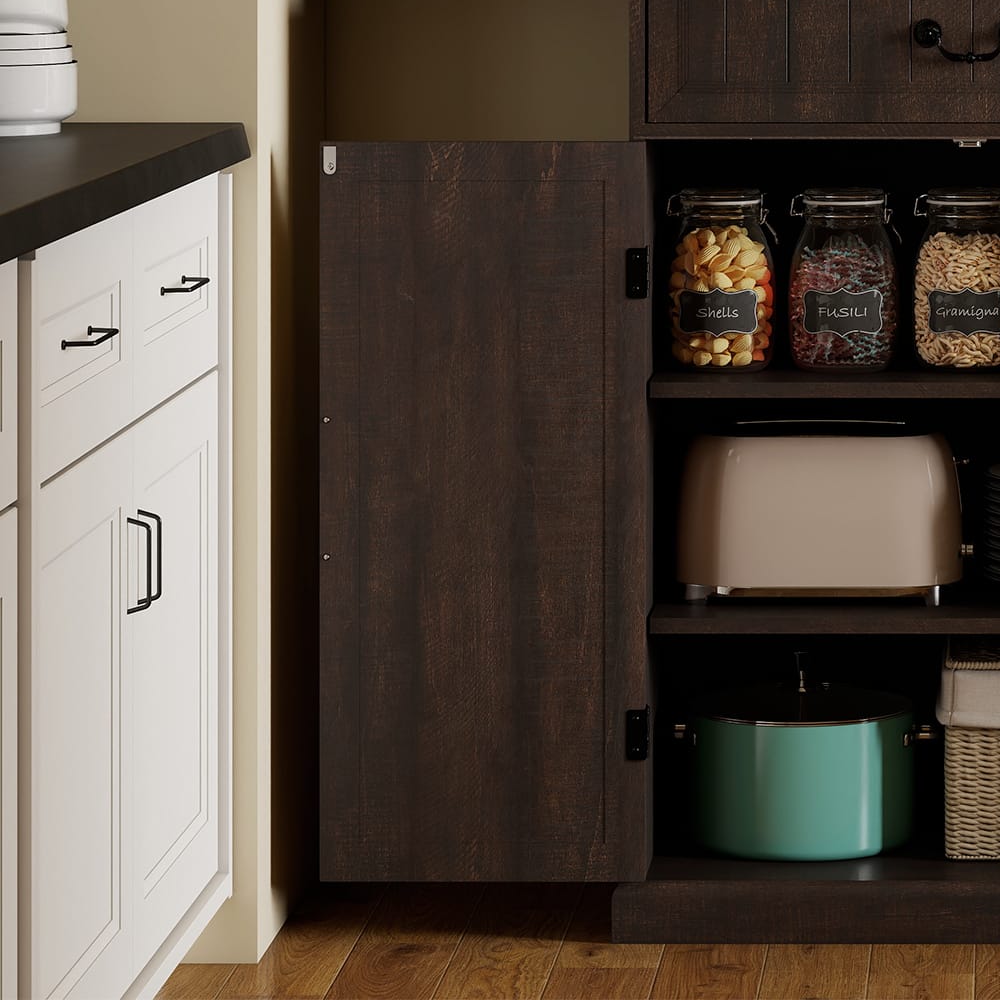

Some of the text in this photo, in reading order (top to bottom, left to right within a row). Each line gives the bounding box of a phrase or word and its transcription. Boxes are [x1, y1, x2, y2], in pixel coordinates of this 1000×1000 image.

[696, 306, 739, 318] Shells
[818, 306, 867, 318] FUSILI
[935, 306, 1000, 320] Gramigna
